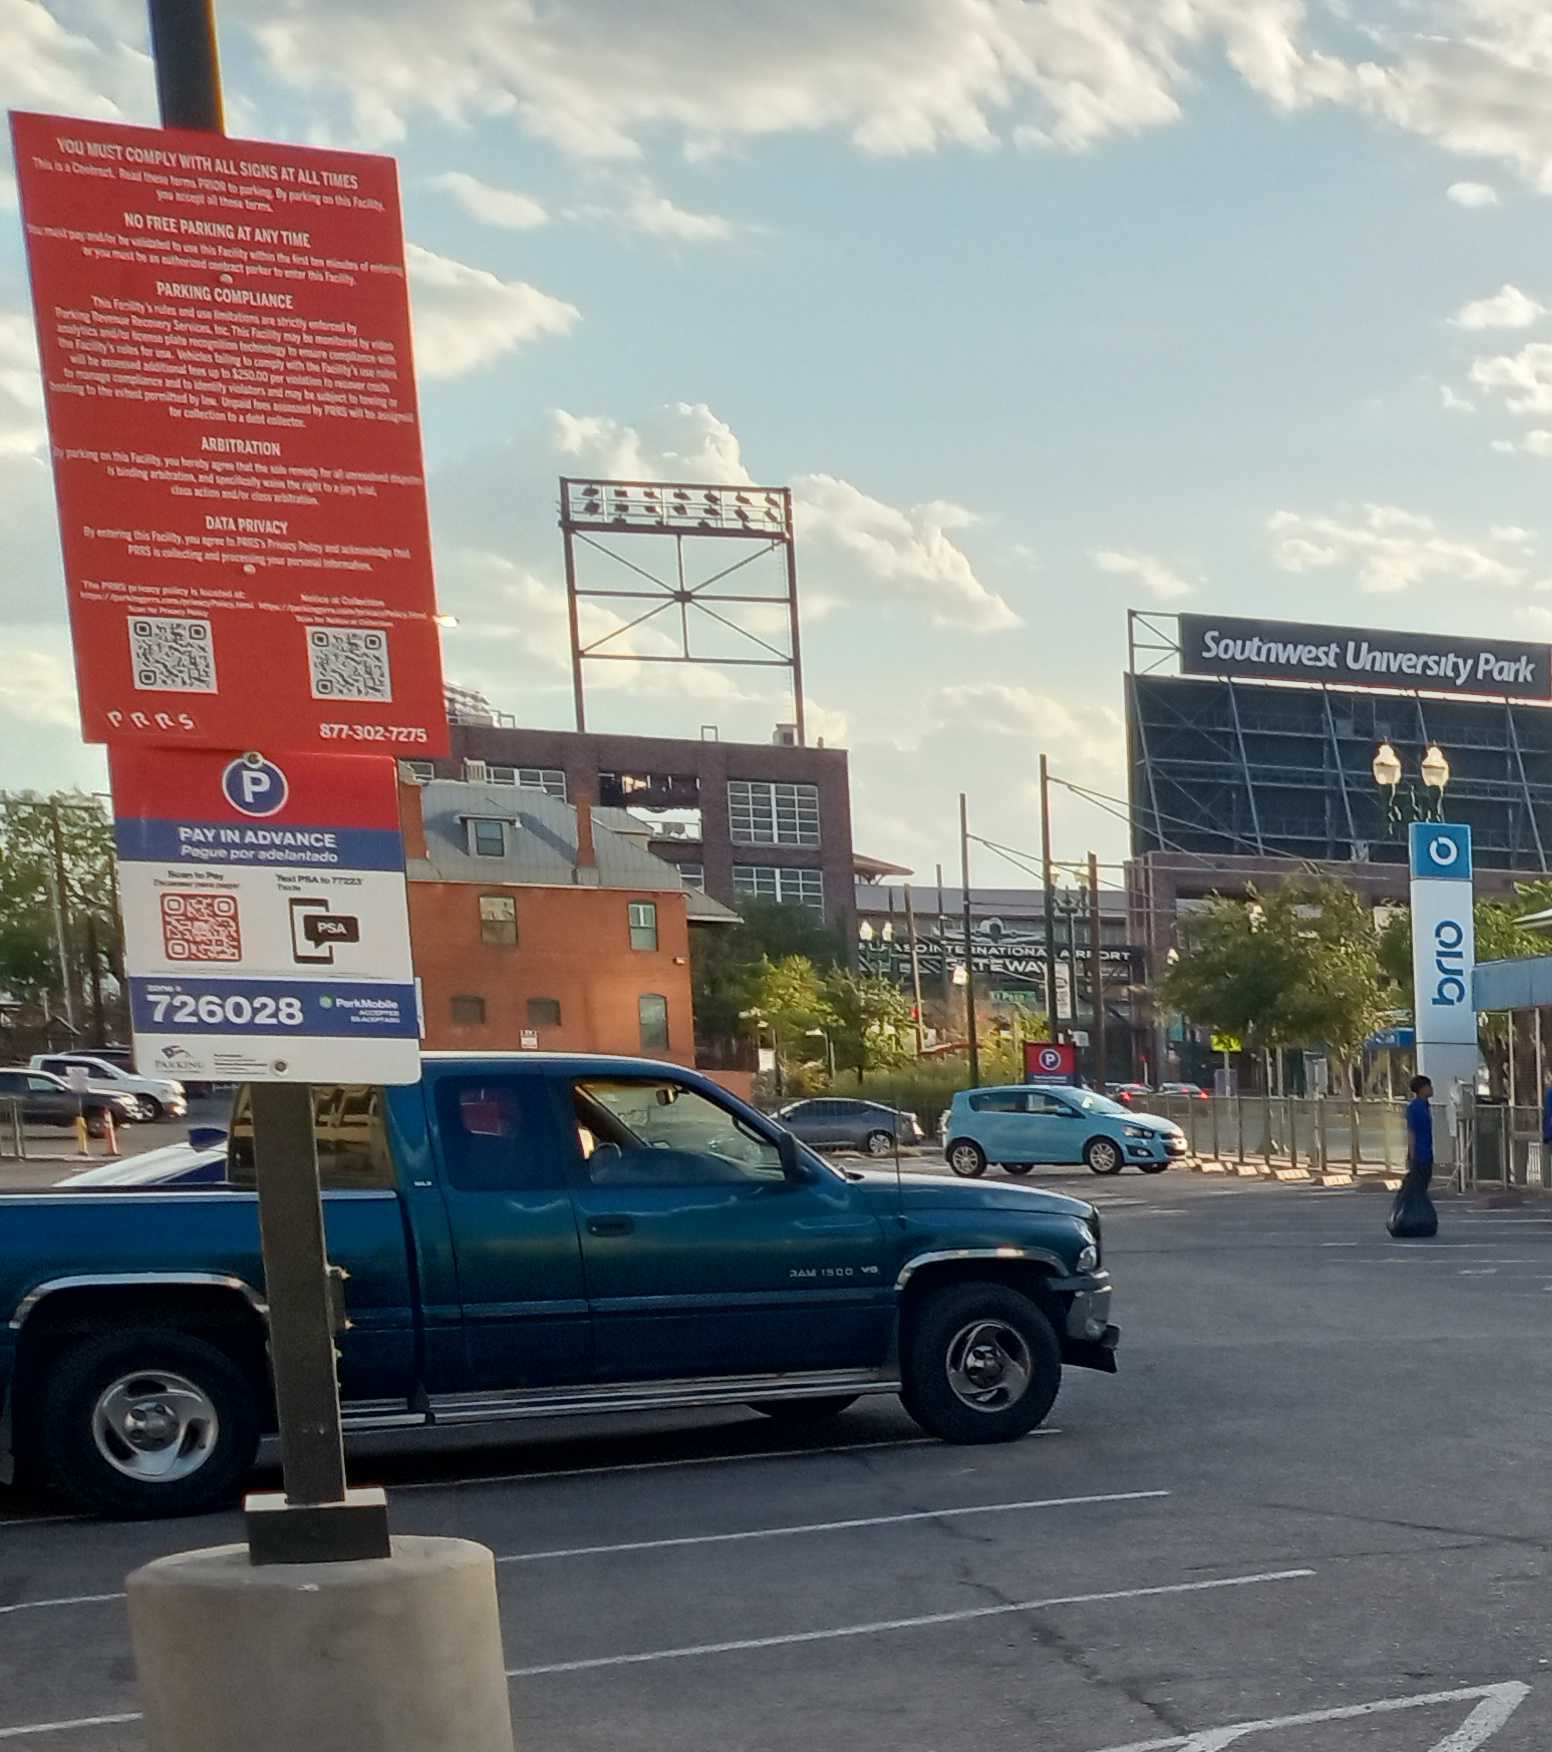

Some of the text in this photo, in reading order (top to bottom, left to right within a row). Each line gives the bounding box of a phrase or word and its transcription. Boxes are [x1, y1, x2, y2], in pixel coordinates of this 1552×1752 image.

[56, 137, 359, 190] YOU MUST COMPLY WITH ALL SIGNS AT ALL TIMES
[123, 212, 312, 249] NO FREE PARKING AT ANY TIME
[156, 281, 294, 310] PARKING COMPLIANCE
[201, 436, 281, 457] ARBITRATION
[205, 515, 288, 535] DATA PRIVACY
[1202, 630, 1537, 686] Southwest University Park
[319, 722, 427, 743] 877-302-7275
[242, 770, 271, 803] P
[178, 826, 338, 848] PAY IN ADVANCE
[181, 845, 338, 863] Pague por adelantado
[317, 921, 348, 934] PSA
[1431, 920, 1466, 1006] brio
[146, 994, 399, 1025] 726028 ParkMobile
[1045, 1053, 1056, 1066] P
